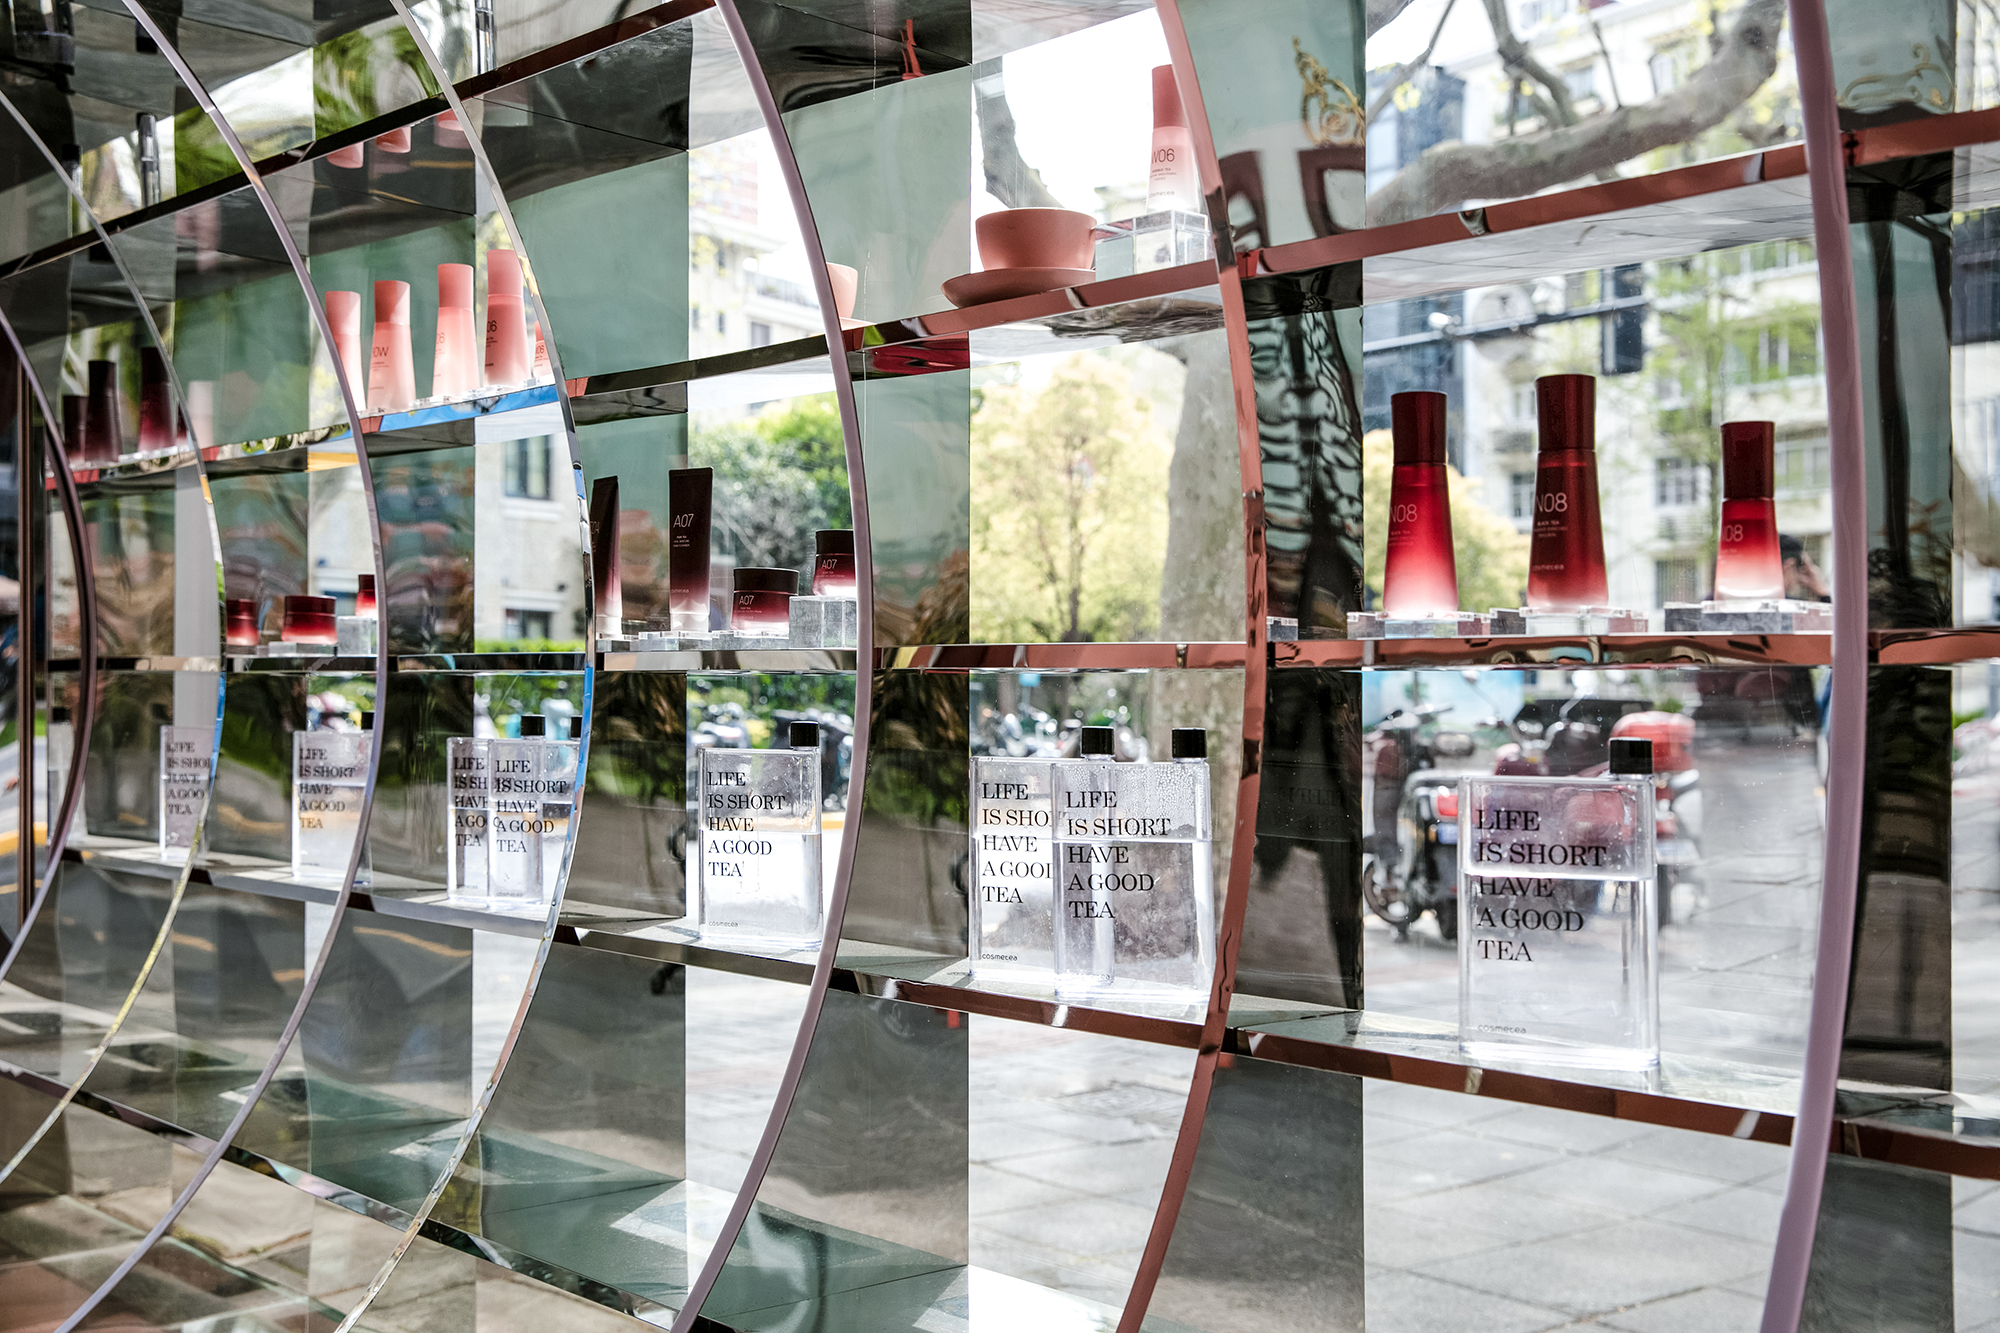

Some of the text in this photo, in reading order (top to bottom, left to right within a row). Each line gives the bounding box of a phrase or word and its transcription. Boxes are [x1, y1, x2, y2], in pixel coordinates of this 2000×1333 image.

[673, 513, 694, 528] A07
[822, 559, 837, 570] A07
[739, 595, 754, 605] A07
[167, 742, 195, 753] LIFE
[299, 748, 327, 760] LIFE
[454, 757, 484, 770] LIFE
[496, 760, 531, 773] LIFE
[299, 766, 356, 778] IS SHORT
[707, 772, 746, 786] LIFE
[300, 783, 333, 794] HAVE
[454, 777, 467, 789] IS
[513, 780, 567, 793] SHORT
[178, 788, 205, 800] GOO
[982, 783, 1028, 800] LIFE
[300, 800, 345, 812] A GOOD
[497, 800, 538, 813] HAVE
[707, 794, 786, 810] IS SHORT
[1066, 791, 1117, 808] LIFE
[167, 804, 192, 815] TEA
[299, 817, 323, 829] TEA
[455, 815, 464, 828] A
[982, 809, 1002, 825] IS
[1477, 809, 1540, 831] LIFE
[496, 820, 554, 833] A GOOD
[708, 817, 754, 832] HAVE
[1067, 818, 1171, 836] IS SHORT
[455, 834, 481, 846] TEA
[497, 840, 527, 853] TEA
[983, 836, 1037, 852] HAVE
[708, 840, 772, 855] A GOOD
[1477, 842, 1607, 867] IS SHORT
[1068, 846, 1129, 864] HAVE
[708, 862, 742, 877] TEA
[982, 861, 996, 877] A
[1068, 873, 1155, 892] A GOOD
[1478, 877, 1553, 897] HAVE
[982, 887, 1023, 904] TEA
[1068, 901, 1115, 918] TEA
[1477, 908, 1585, 932] A GOOD
[1477, 940, 1534, 962] TEA
